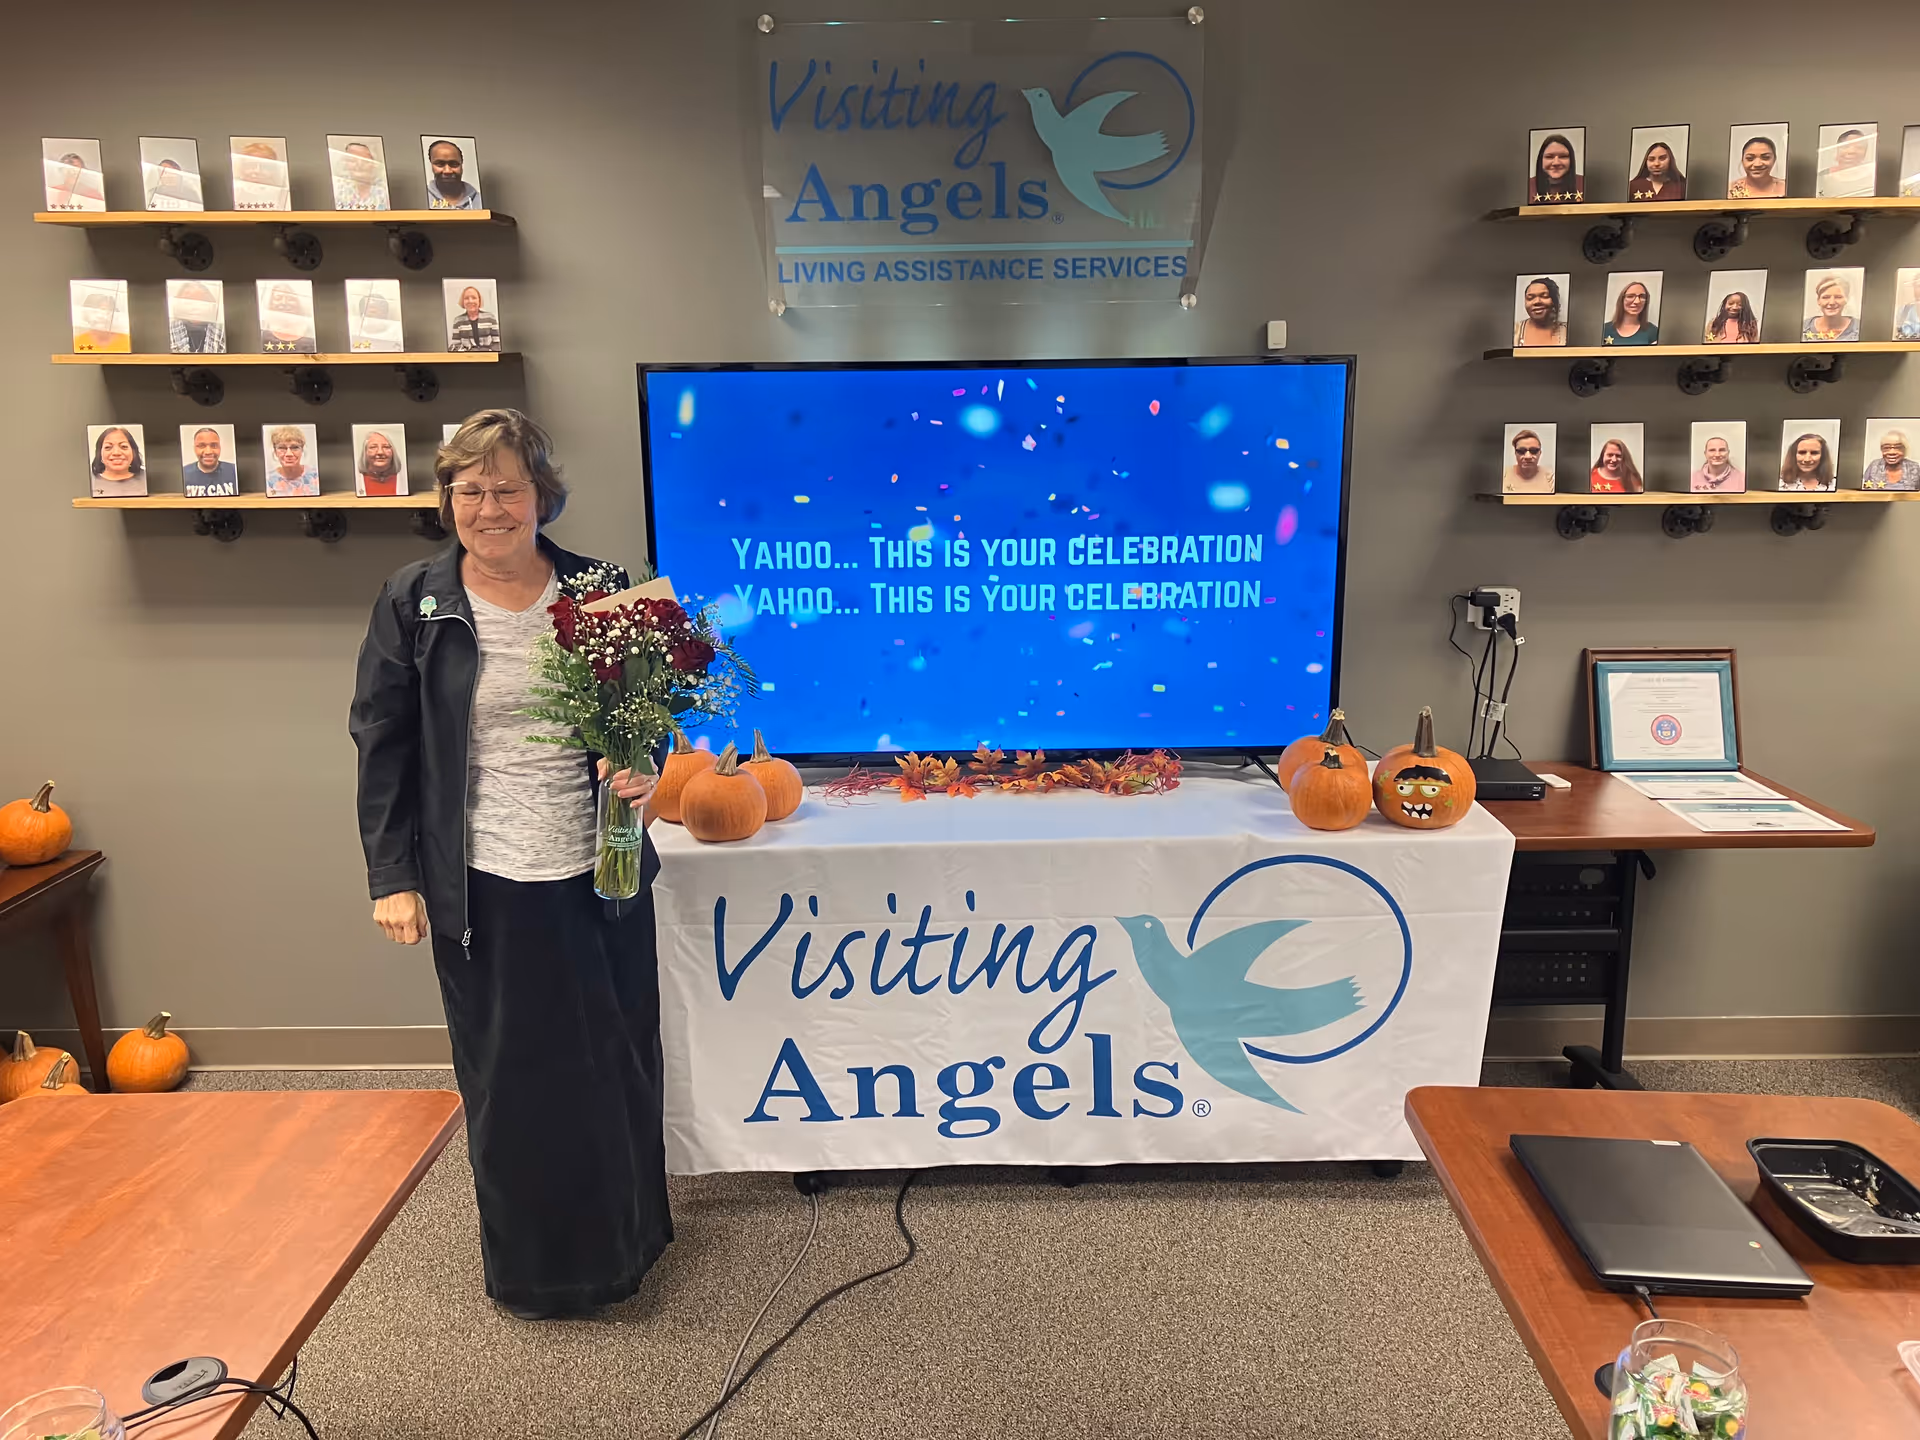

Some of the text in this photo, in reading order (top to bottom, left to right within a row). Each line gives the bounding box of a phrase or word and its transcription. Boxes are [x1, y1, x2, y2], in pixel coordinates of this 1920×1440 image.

[769, 58, 1008, 170] Visiting
[778, 254, 1188, 284] LIVING ASSISTANCE SERVICES
[207, 482, 234, 496] CAN
[869, 536, 933, 569] THIS
[944, 538, 971, 568] IS
[981, 537, 1057, 567] YOUR
[1067, 533, 1263, 567] CELEBRATION
[870, 582, 933, 614] THIS
[944, 582, 971, 613] IS
[981, 582, 1057, 612] YOUR
[1067, 580, 1262, 611] CELEBRATION
[713, 890, 1118, 1055] Visiting
